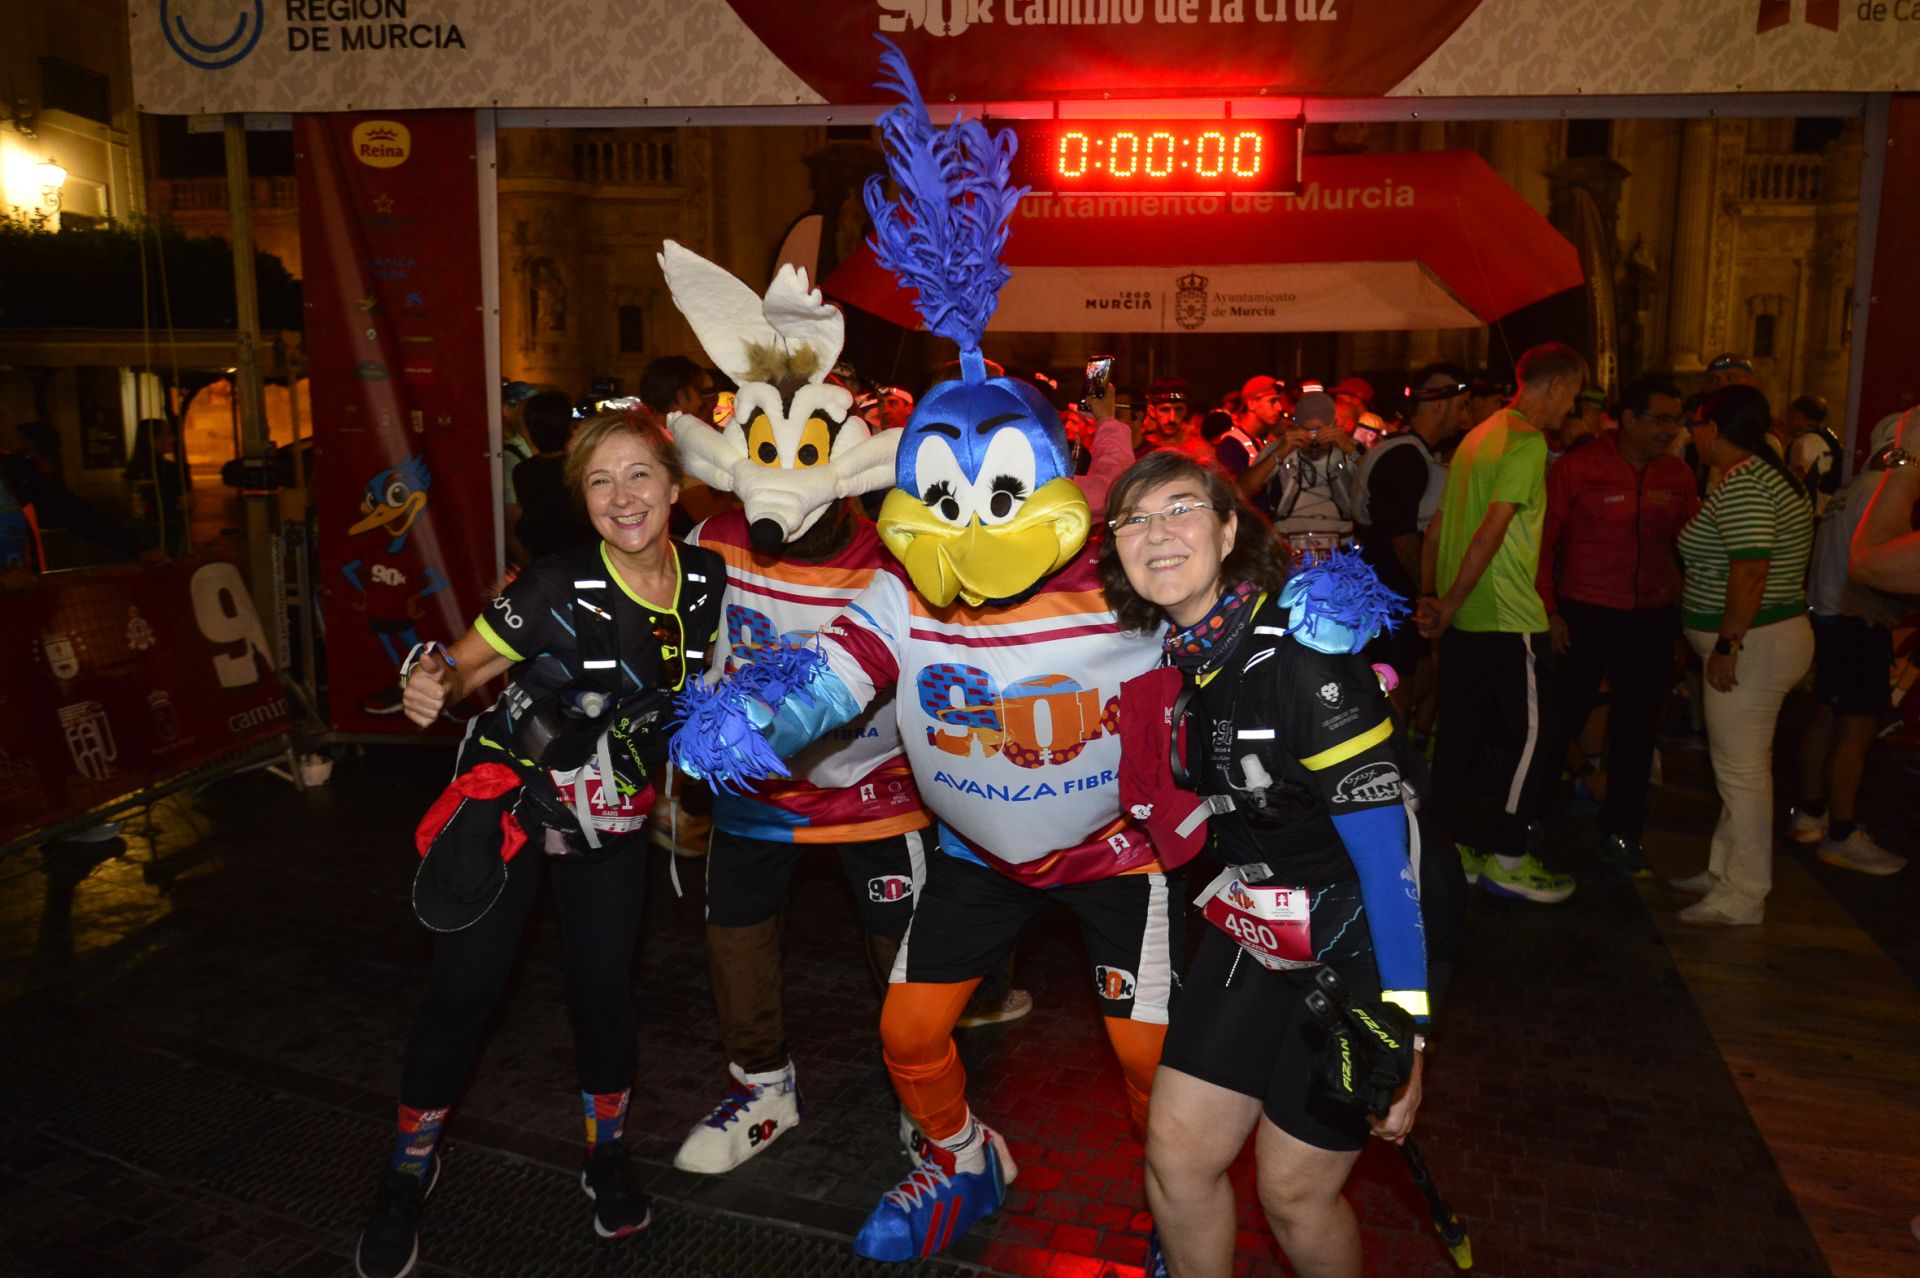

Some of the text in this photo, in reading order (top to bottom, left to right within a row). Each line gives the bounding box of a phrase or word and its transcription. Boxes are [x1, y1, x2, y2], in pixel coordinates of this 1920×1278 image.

[1857, 0, 1887, 22] de
[288, 24, 467, 51] DE MURCIA
[360, 143, 404, 158] Reina
[1058, 132, 1262, 177] 0:00:00
[1286, 178, 1415, 212] Murcia
[1086, 299, 1152, 310] MURCIA
[1213, 292, 1296, 304] Ayuntamiento
[1230, 305, 1275, 317] Murcia
[591, 786, 633, 810] 41
[934, 770, 1056, 802] AVANZA
[1225, 913, 1278, 950] 480
[1352, 1007, 1400, 1050] FIZAN
[1339, 1037, 1353, 1093] FIZAN
